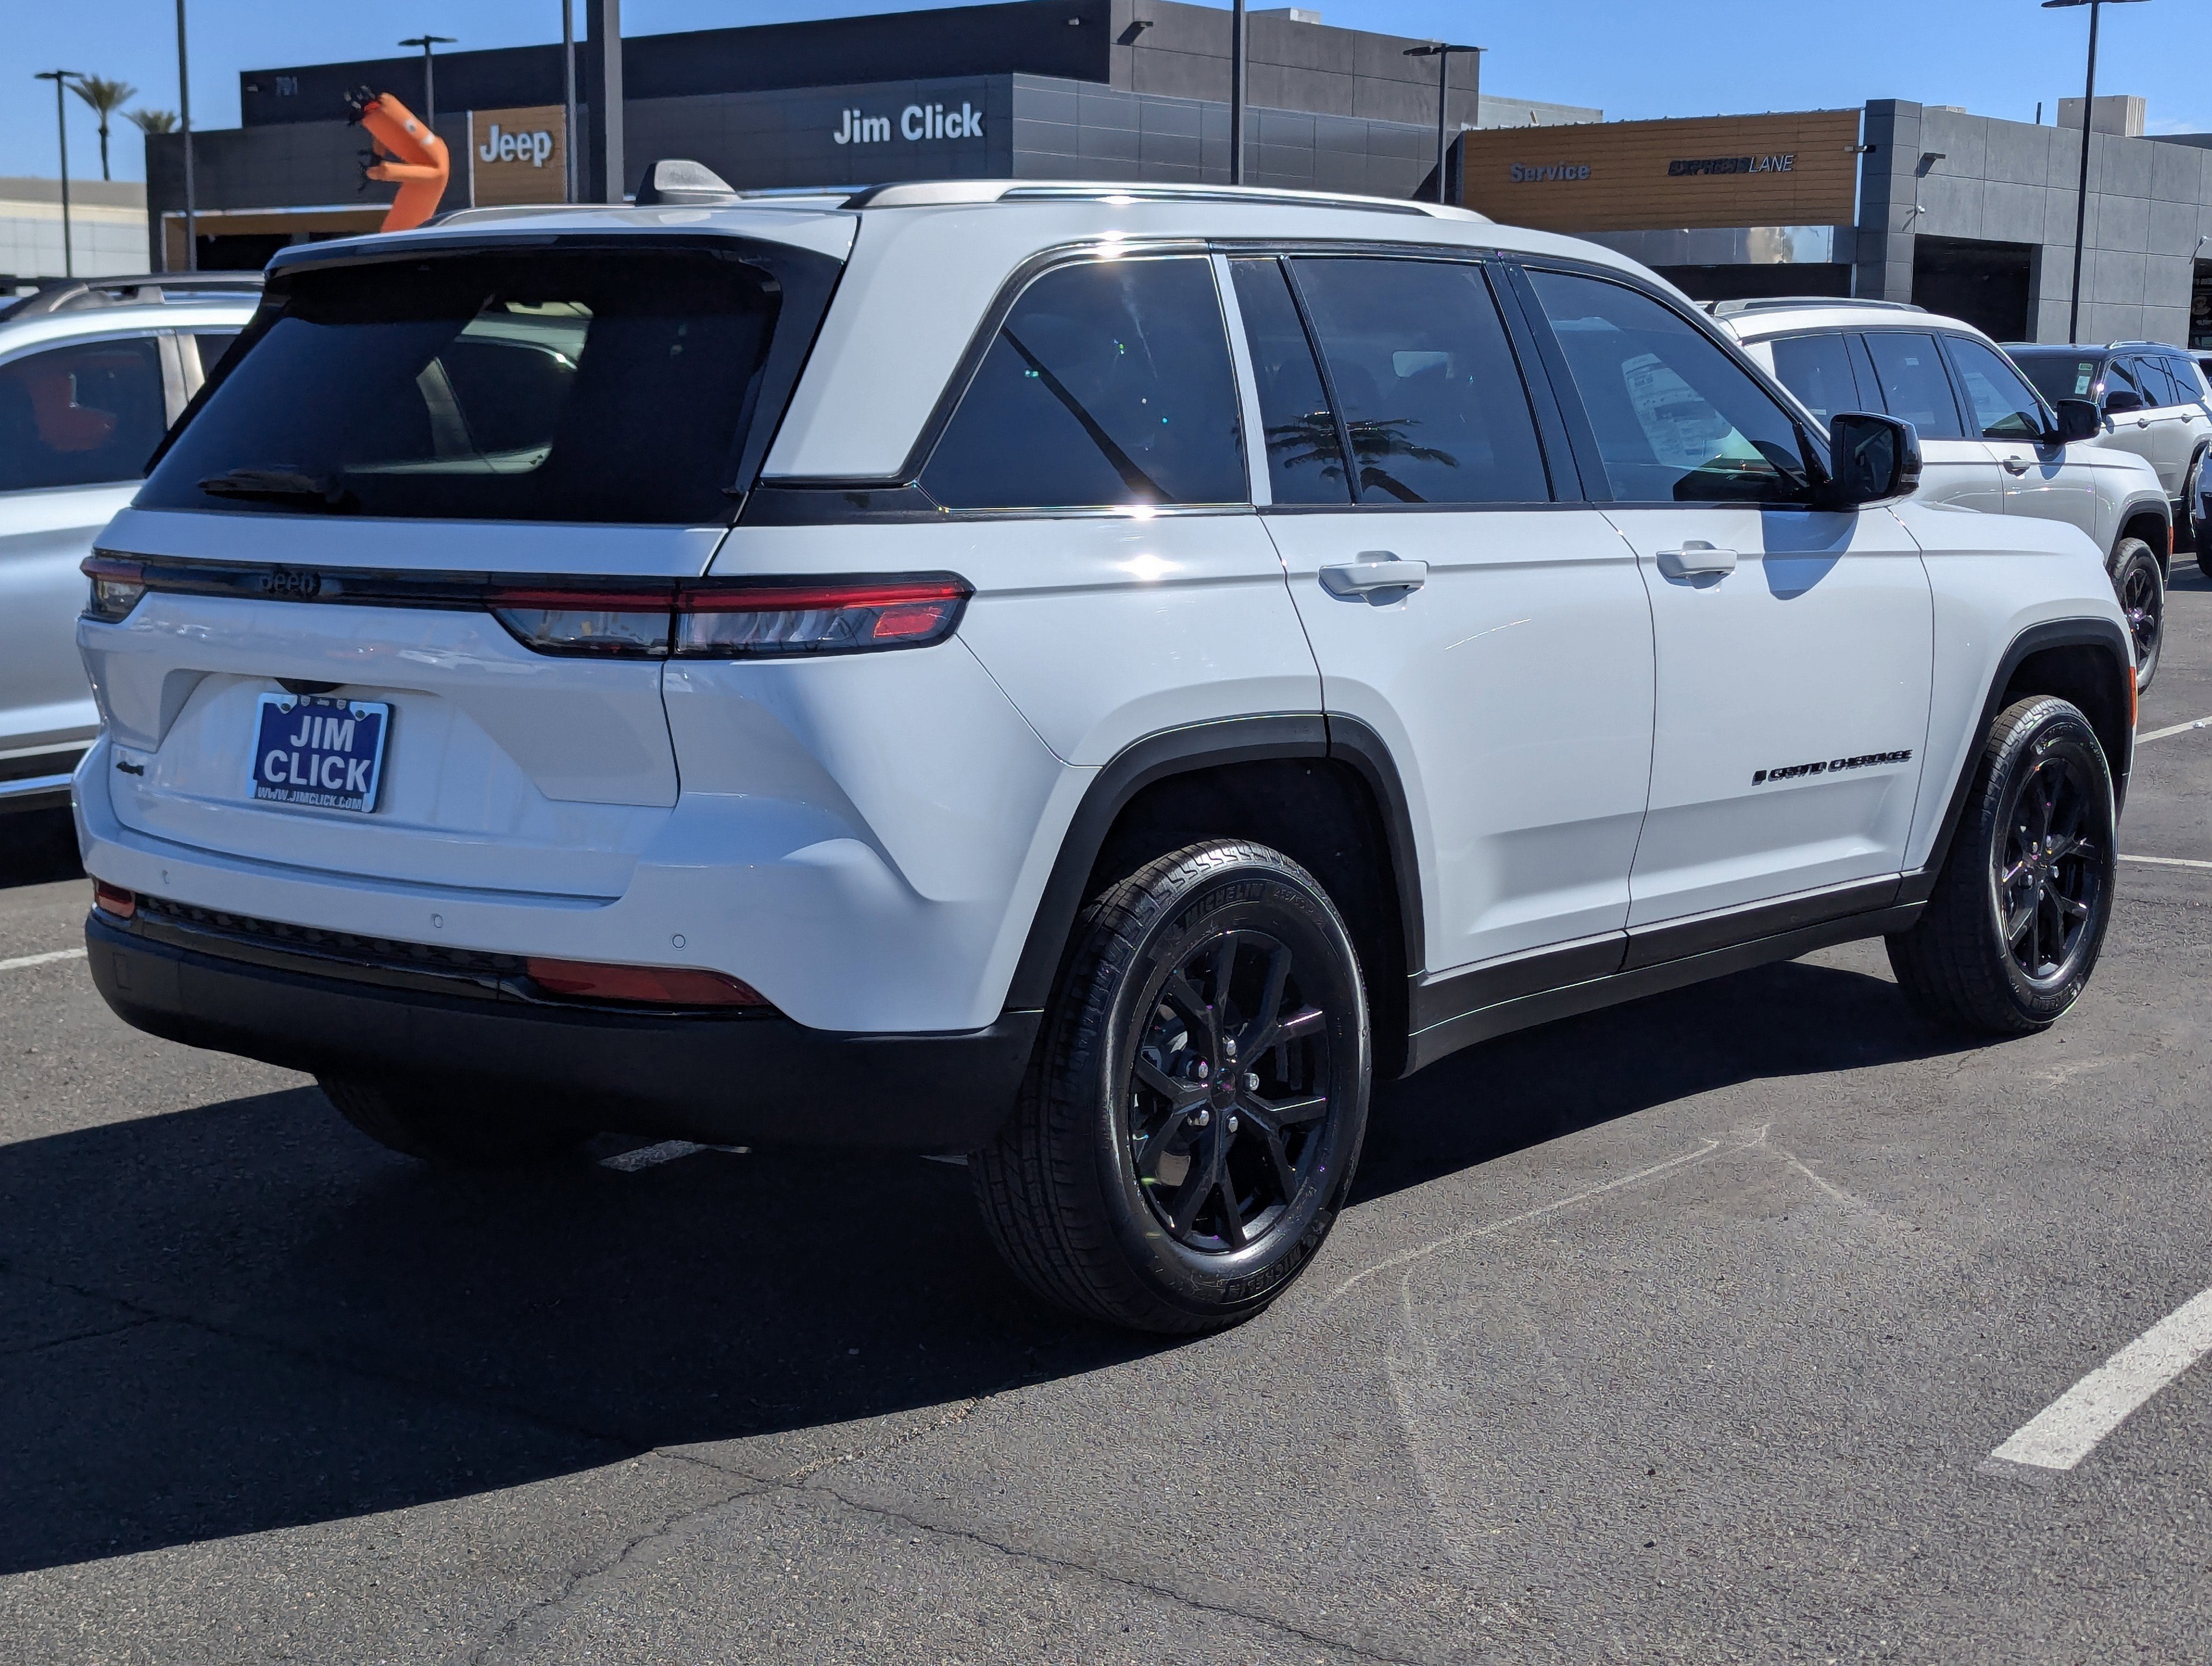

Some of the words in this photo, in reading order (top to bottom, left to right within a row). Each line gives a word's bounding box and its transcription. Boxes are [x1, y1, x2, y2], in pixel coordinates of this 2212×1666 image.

[833, 109, 891, 144] Jim
[901, 102, 983, 141] Click
[479, 124, 552, 168] Jeep
[1510, 161, 1591, 182] Service
[290, 715, 355, 752] JIM
[264, 749, 371, 793] CLICK
